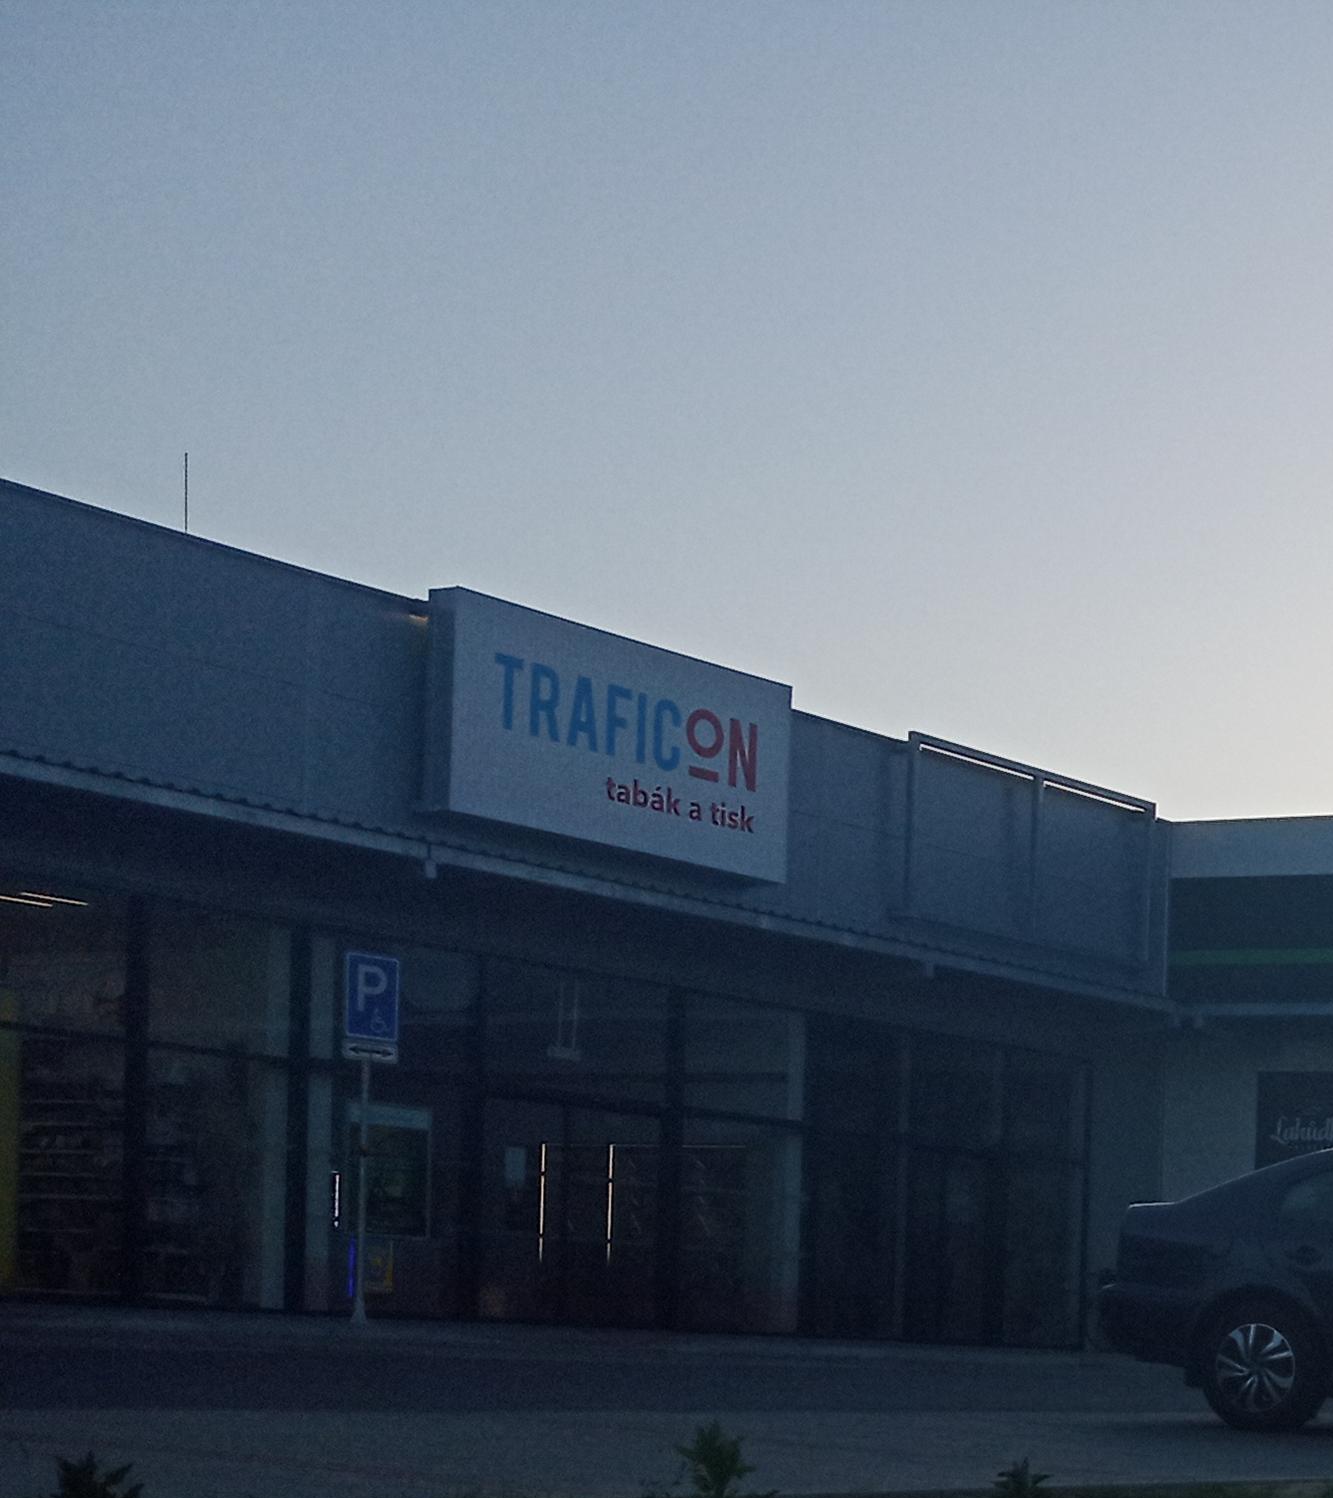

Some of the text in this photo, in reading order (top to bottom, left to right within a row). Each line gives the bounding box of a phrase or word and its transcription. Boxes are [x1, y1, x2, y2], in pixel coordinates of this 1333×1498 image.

[495, 653, 758, 792] TRAFICON
[606, 776, 754, 834] tabák a tisk
[357, 963, 388, 1012] P
